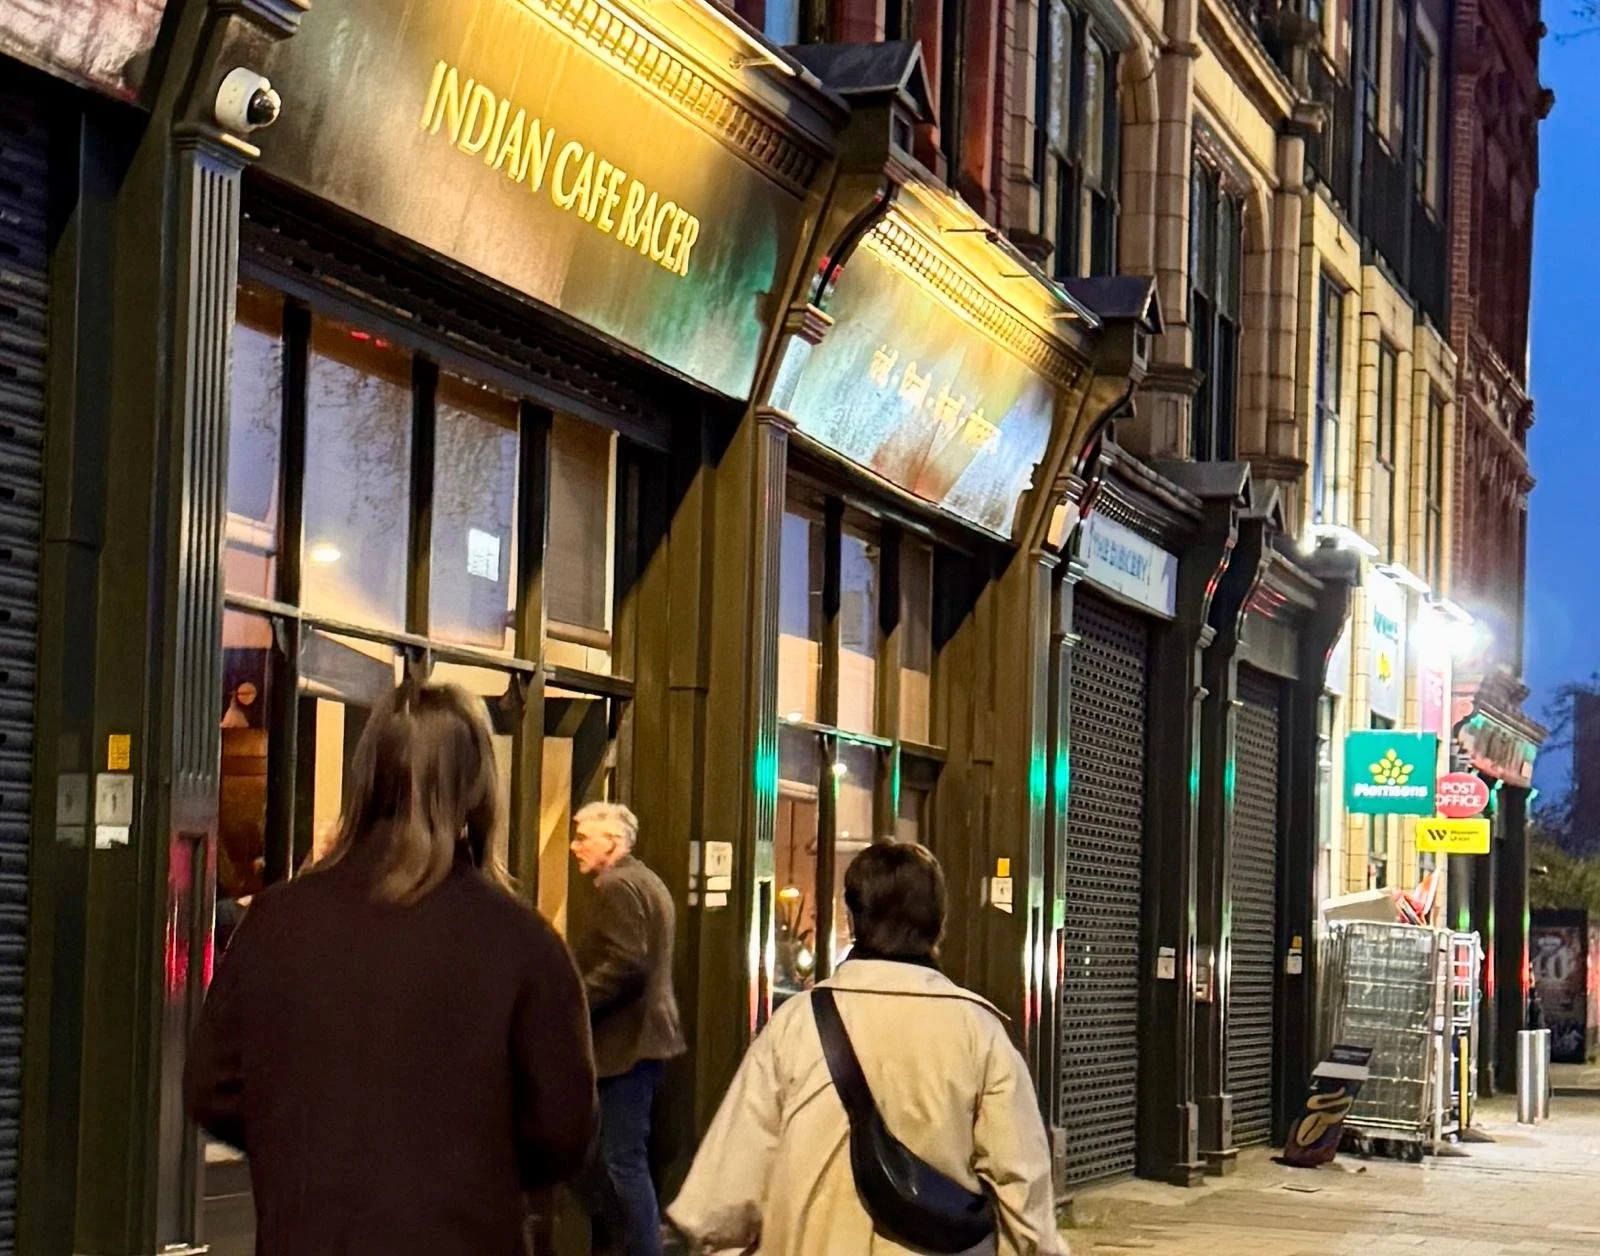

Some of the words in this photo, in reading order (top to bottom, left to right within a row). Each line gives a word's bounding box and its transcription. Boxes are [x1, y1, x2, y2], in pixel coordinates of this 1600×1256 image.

[420, 60, 556, 192] INDIAN
[551, 140, 627, 233] CAFE
[616, 179, 700, 277] RACER
[1441, 781, 1476, 794] POST
[1435, 794, 1481, 807] OFFICE
